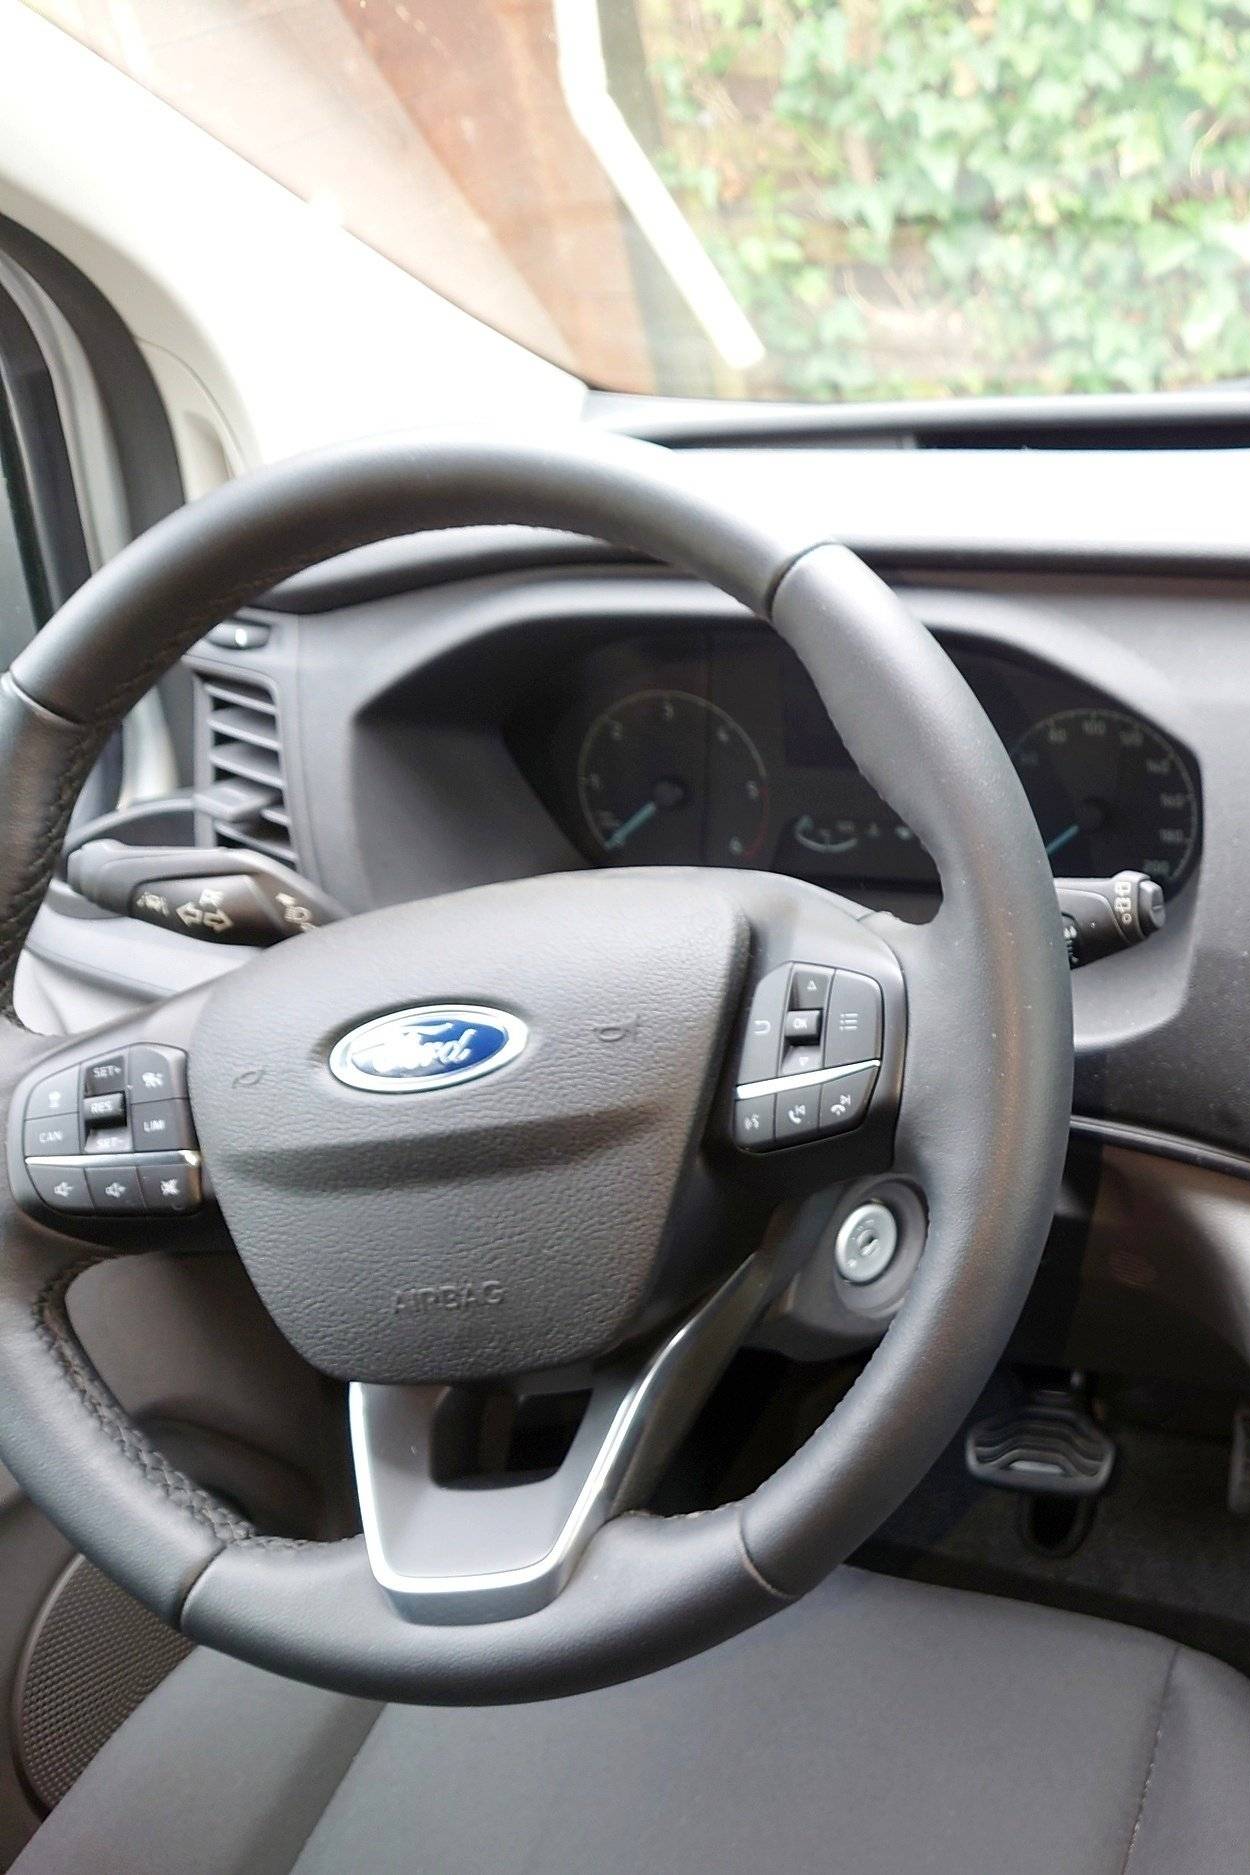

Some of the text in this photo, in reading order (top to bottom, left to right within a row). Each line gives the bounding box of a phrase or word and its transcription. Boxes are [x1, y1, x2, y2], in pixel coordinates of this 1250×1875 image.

[360, 1021, 477, 1074] Ford
[91, 1101, 112, 1113] RES
[39, 1131, 63, 1142] CAN
[391, 1280, 505, 1314] AIRBAG
